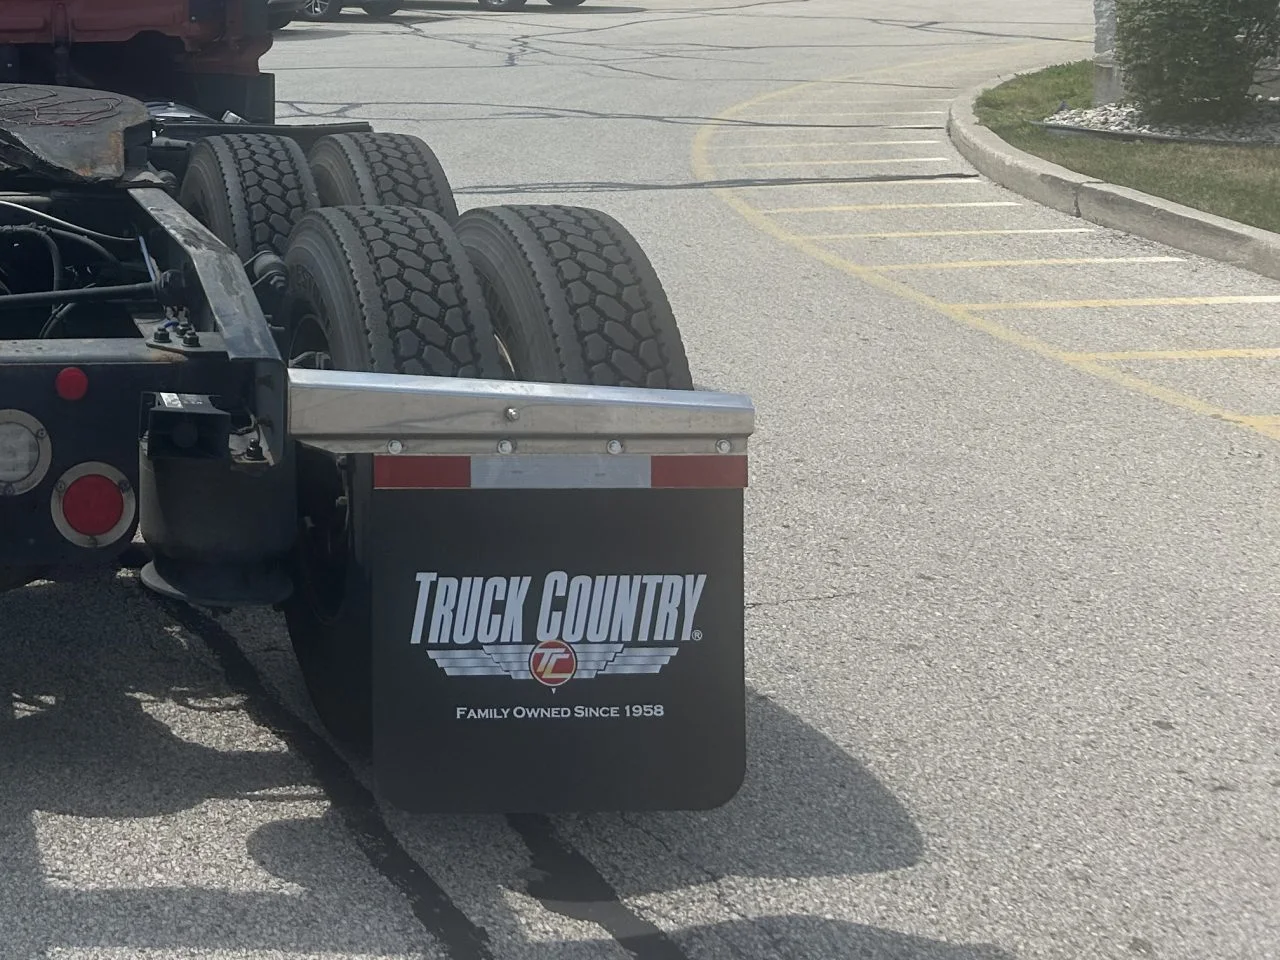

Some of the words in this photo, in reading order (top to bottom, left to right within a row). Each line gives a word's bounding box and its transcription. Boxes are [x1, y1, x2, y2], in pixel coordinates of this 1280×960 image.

[410, 572, 532, 644] TRUCK
[456, 706, 510, 720] FAMILY
[513, 705, 571, 719] OWNED
[574, 704, 620, 718] SINCE
[624, 704, 665, 718] 1958
